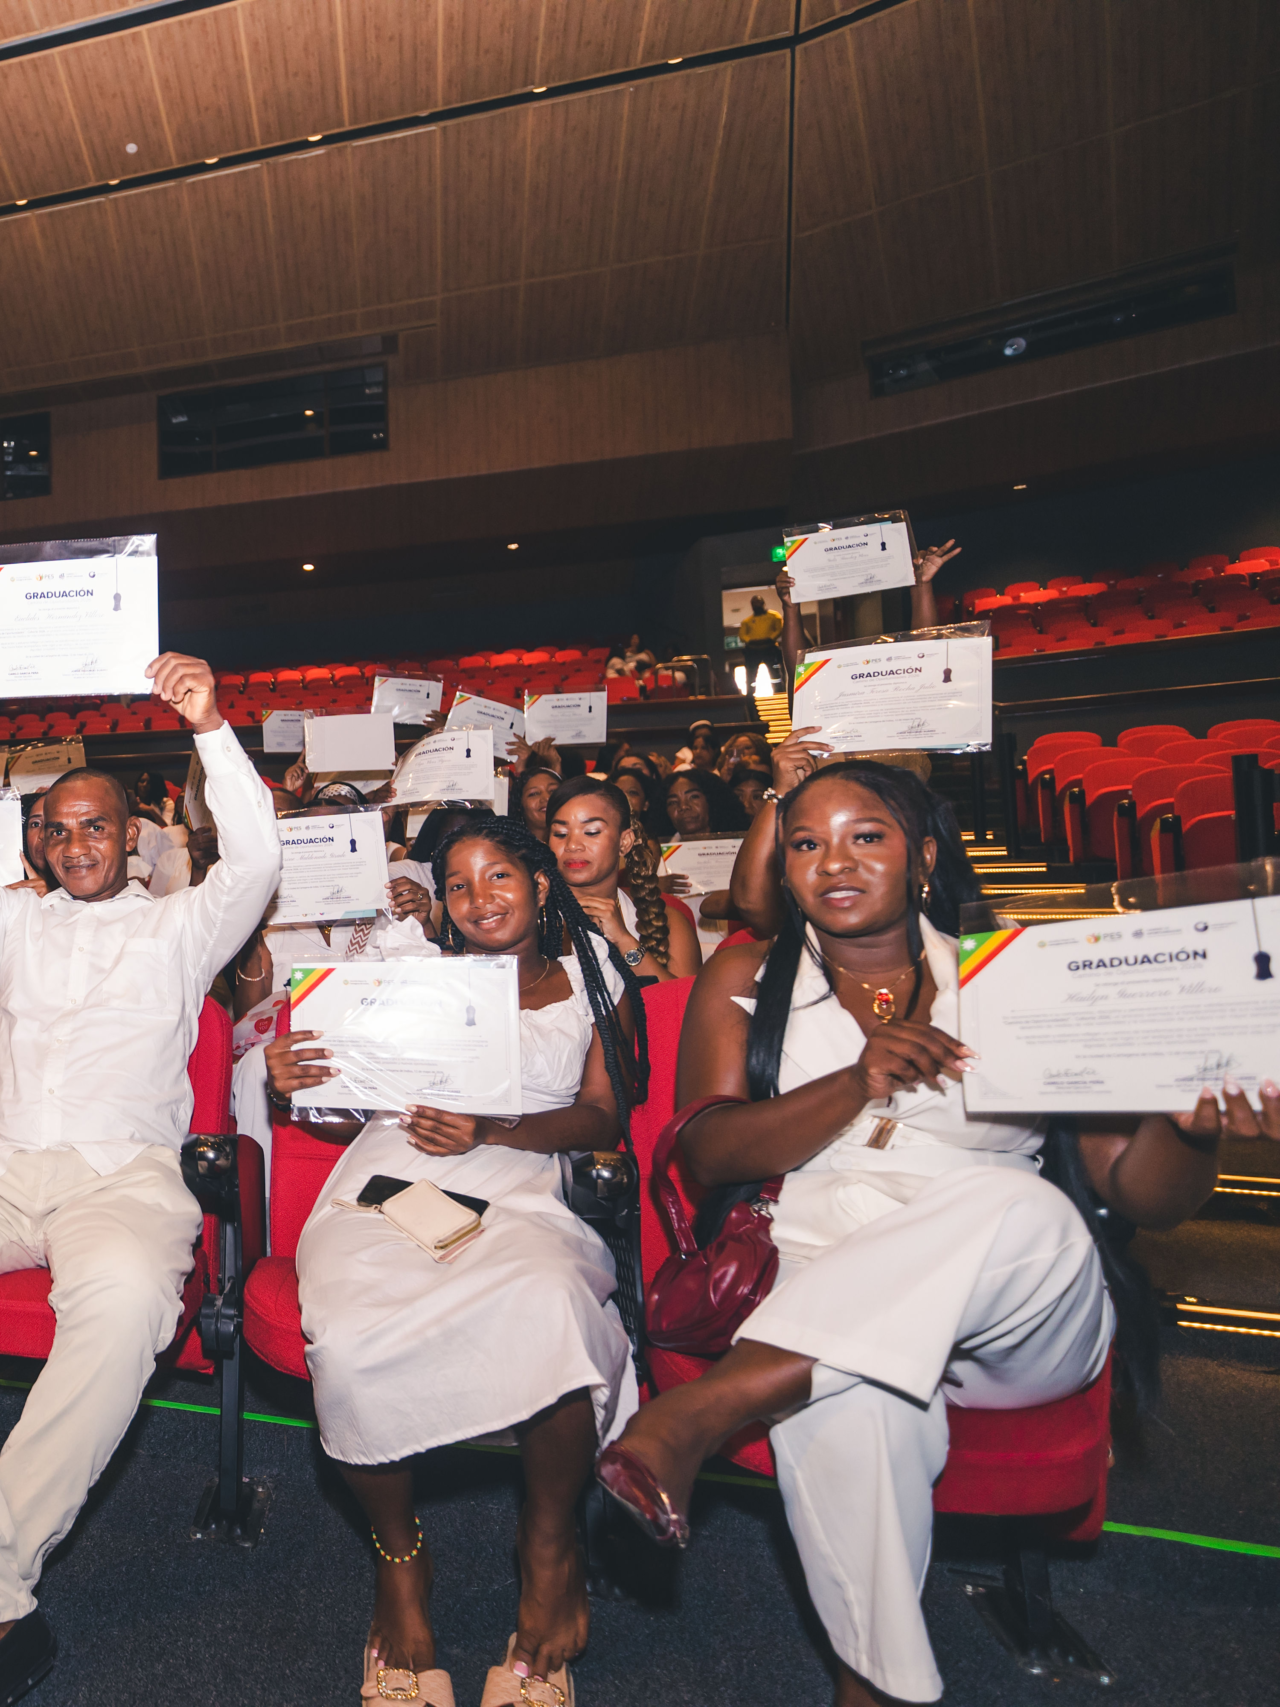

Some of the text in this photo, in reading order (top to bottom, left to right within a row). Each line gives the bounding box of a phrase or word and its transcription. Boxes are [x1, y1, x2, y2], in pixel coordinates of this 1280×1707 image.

[824, 541, 868, 552] GRADUACIÓN
[25, 588, 94, 600] GRADUACIÓN
[851, 666, 922, 680] GRADUACIÓN
[280, 835, 334, 846] GRADUACIÓN
[1103, 932, 1122, 941] PES
[1067, 947, 1208, 972] GRADUACIÓN
[1115, 965, 1177, 976] Oportunidades
